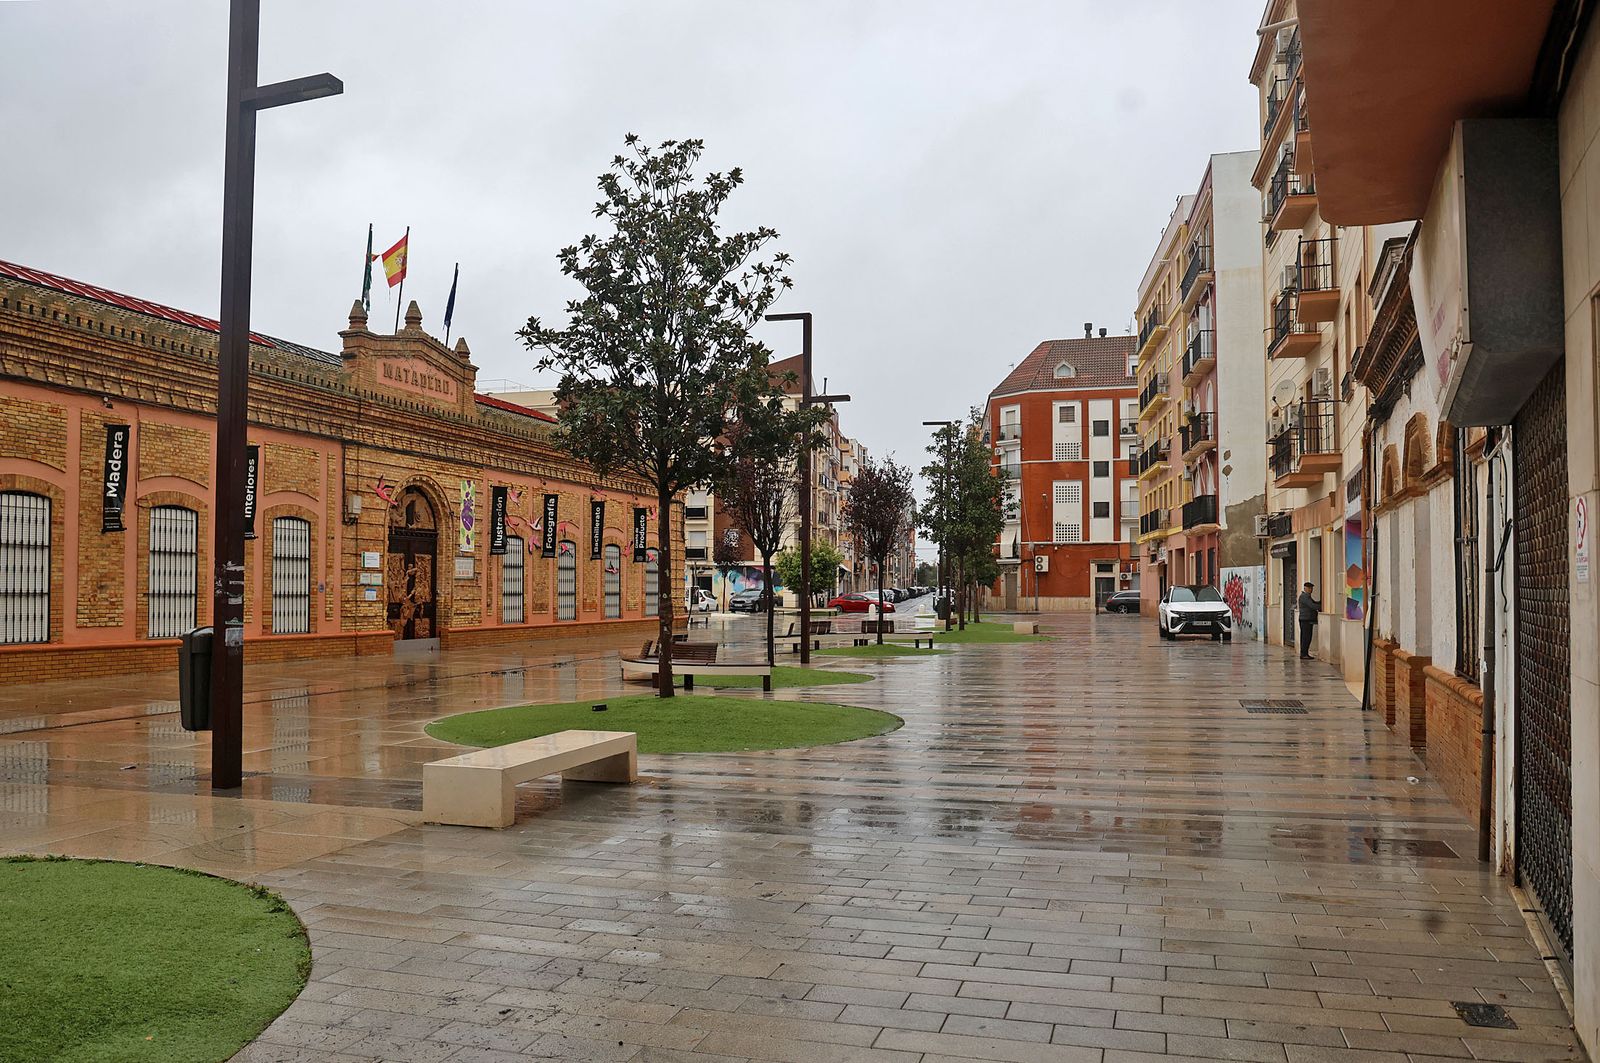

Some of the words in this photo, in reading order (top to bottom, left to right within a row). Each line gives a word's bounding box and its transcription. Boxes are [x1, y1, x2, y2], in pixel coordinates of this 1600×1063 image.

[106, 431, 124, 498] Madera
[493, 496, 504, 546] Ilustración
[545, 498, 556, 549] Fotografía
[593, 506, 601, 553] Bachillerato
[638, 514, 646, 549] Producto
